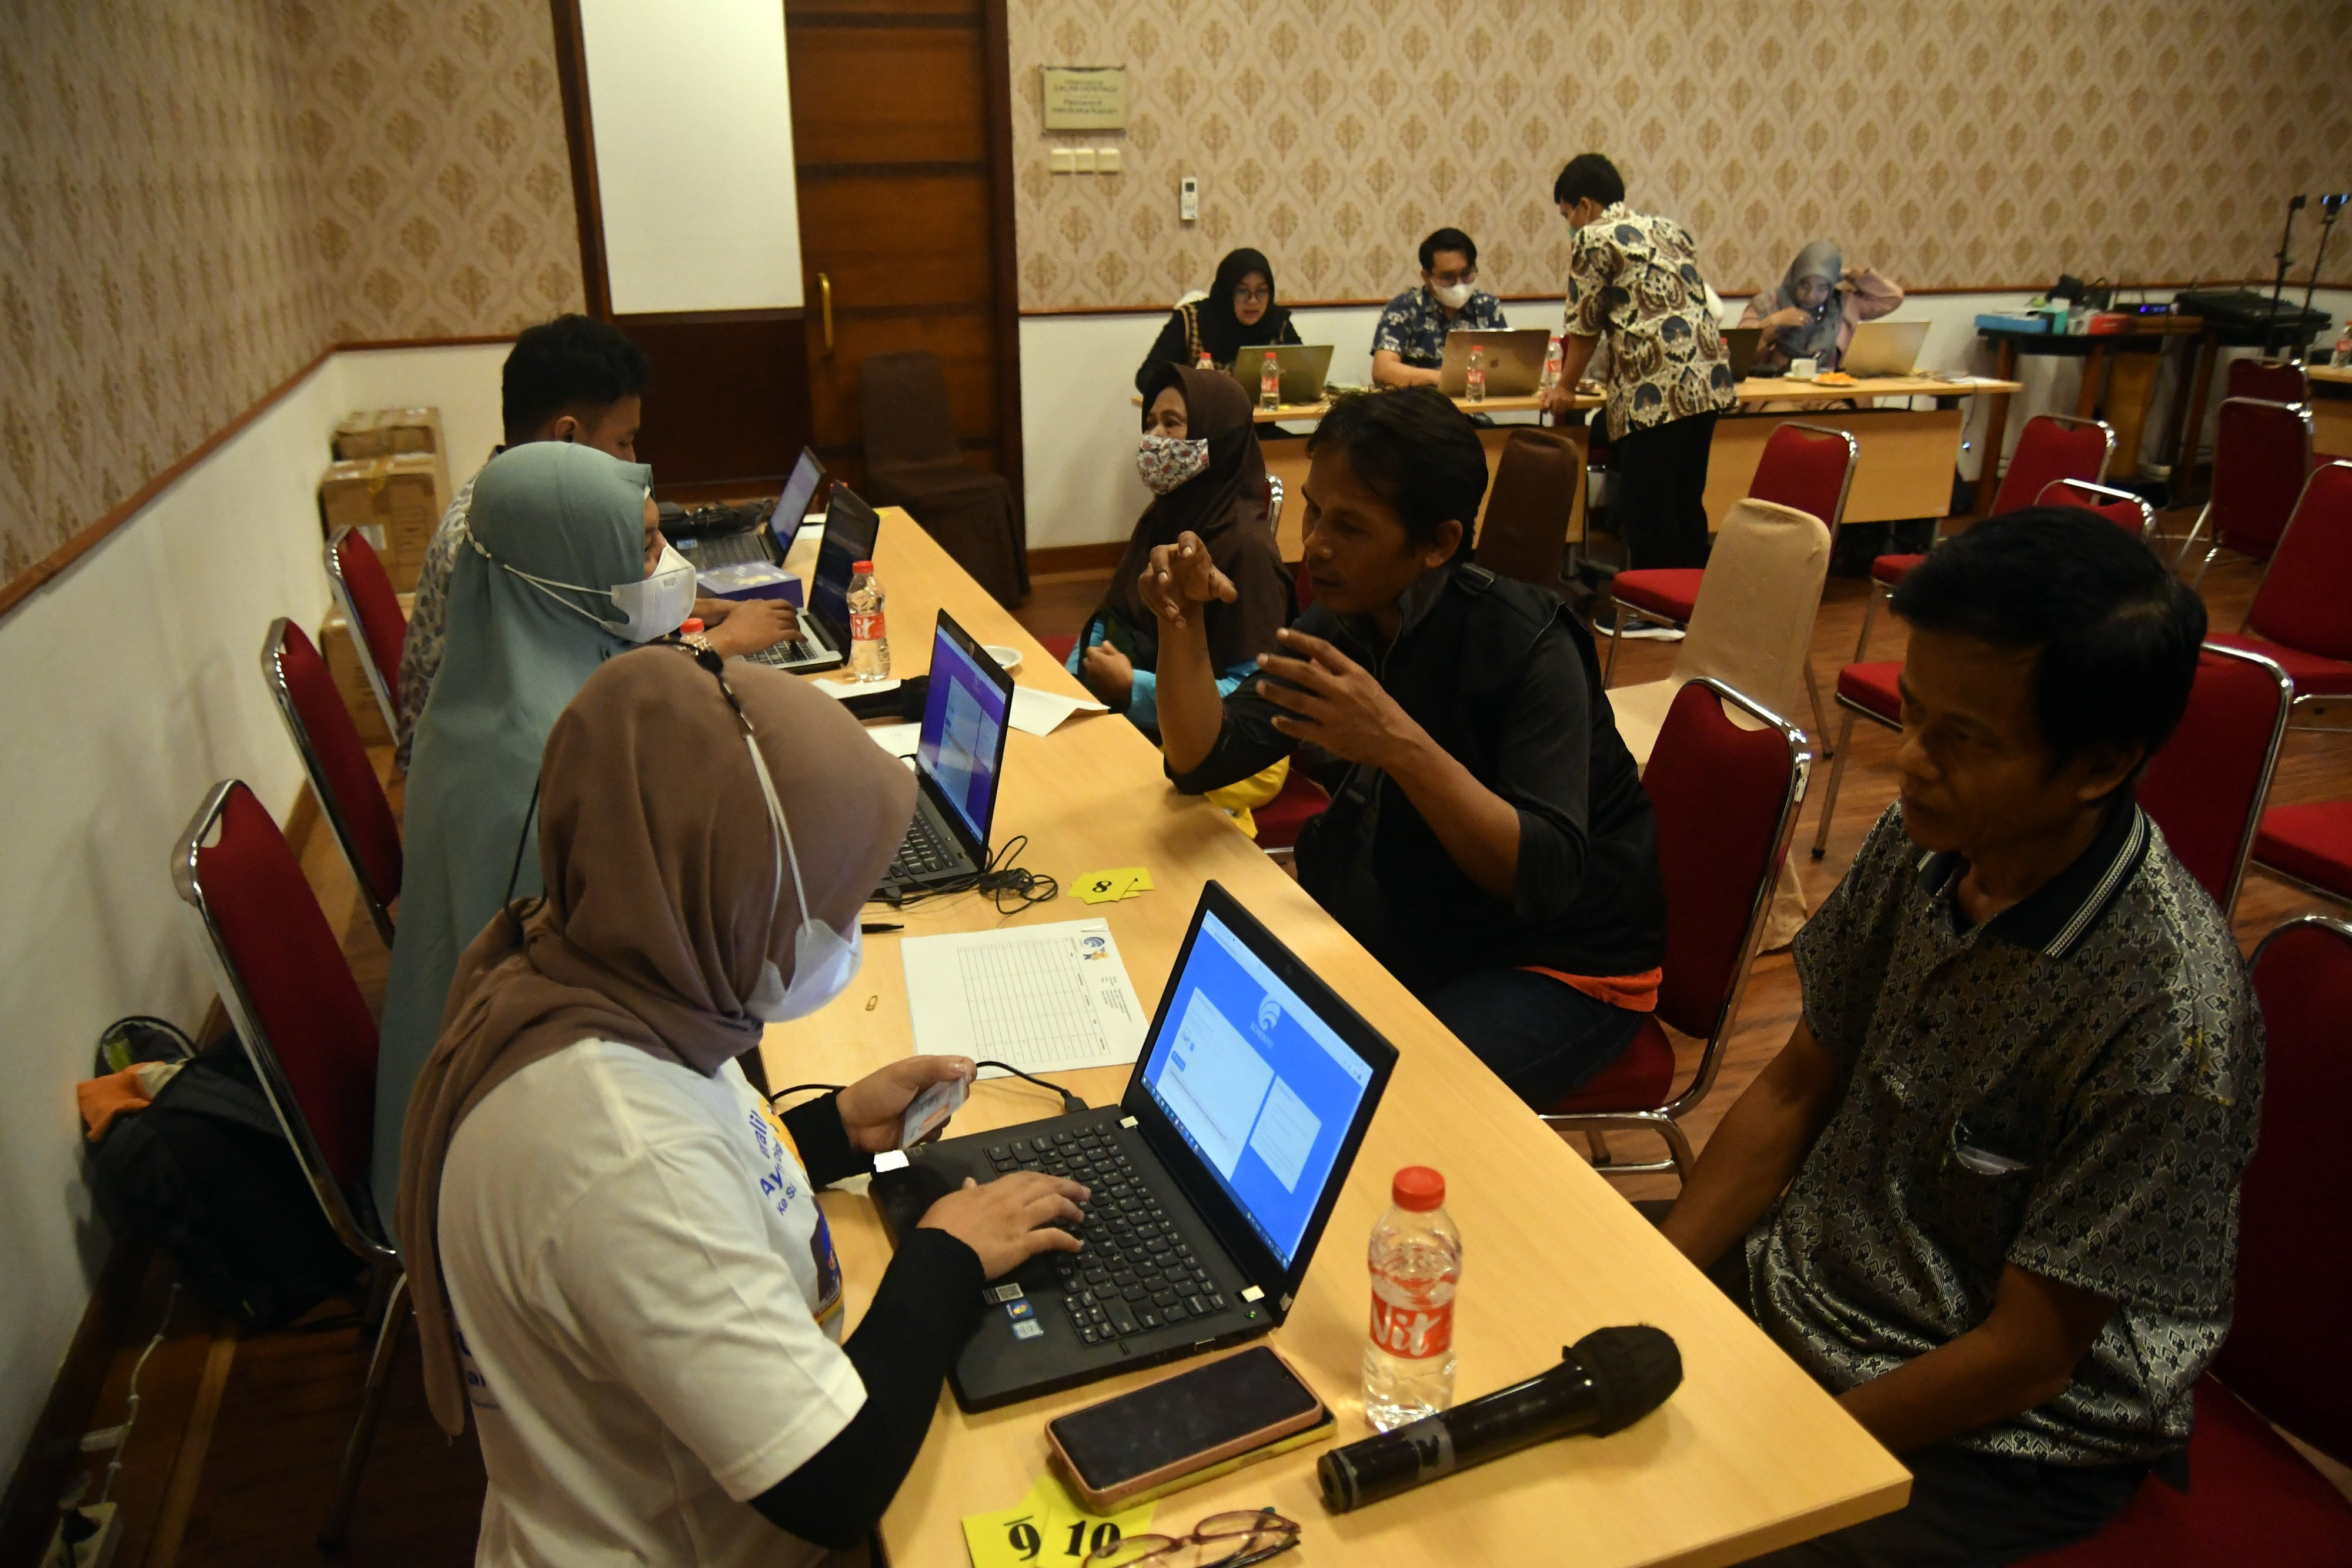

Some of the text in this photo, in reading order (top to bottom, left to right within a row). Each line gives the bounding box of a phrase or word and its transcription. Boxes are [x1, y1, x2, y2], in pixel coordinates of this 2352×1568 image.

[1092, 880, 1112, 893] 8
[1372, 1301, 1441, 1357] Vit
[1064, 1520, 1121, 1559] 10
